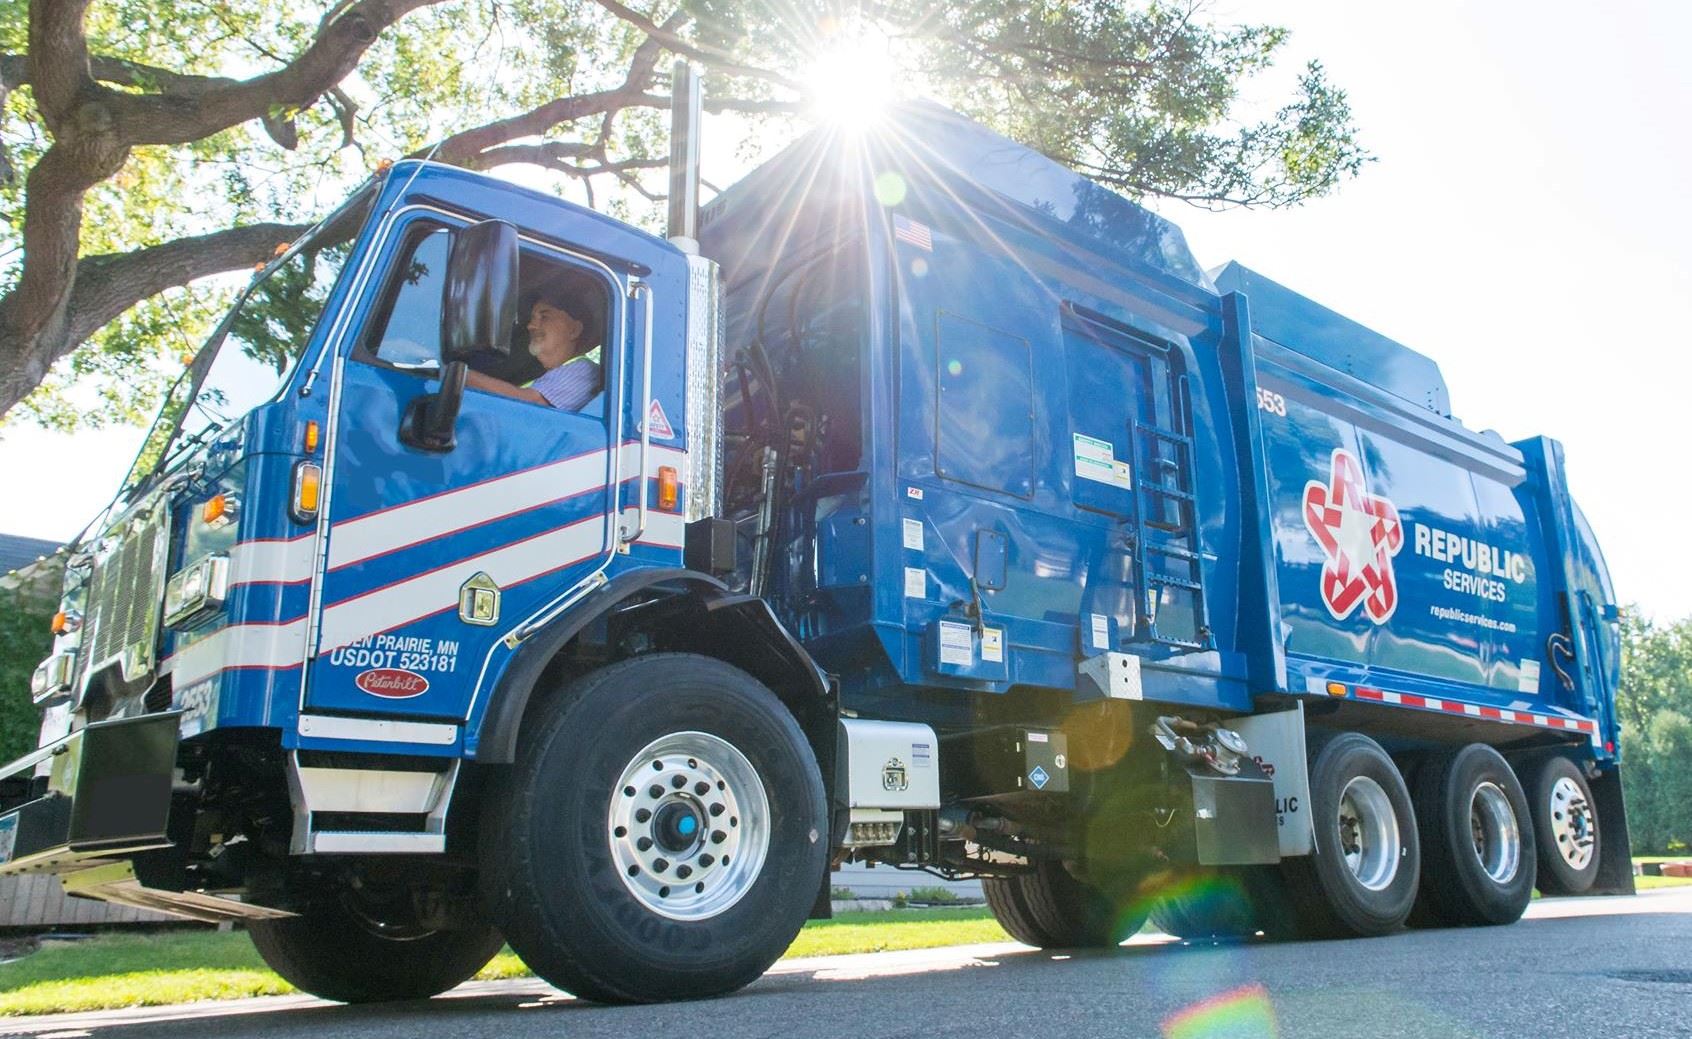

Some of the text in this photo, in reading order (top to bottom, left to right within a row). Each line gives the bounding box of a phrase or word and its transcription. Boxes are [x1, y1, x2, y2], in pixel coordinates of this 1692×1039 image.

[1414, 523, 1526, 584] REPUBLIC
[1443, 568, 1506, 602] SERVICES
[1430, 605, 1517, 633] republicservices.com
[376, 635, 432, 656] PRAIRIE,
[437, 640, 460, 656] MN
[330, 648, 458, 673] USDOT 523181
[364, 671, 422, 692] Peterbilt
